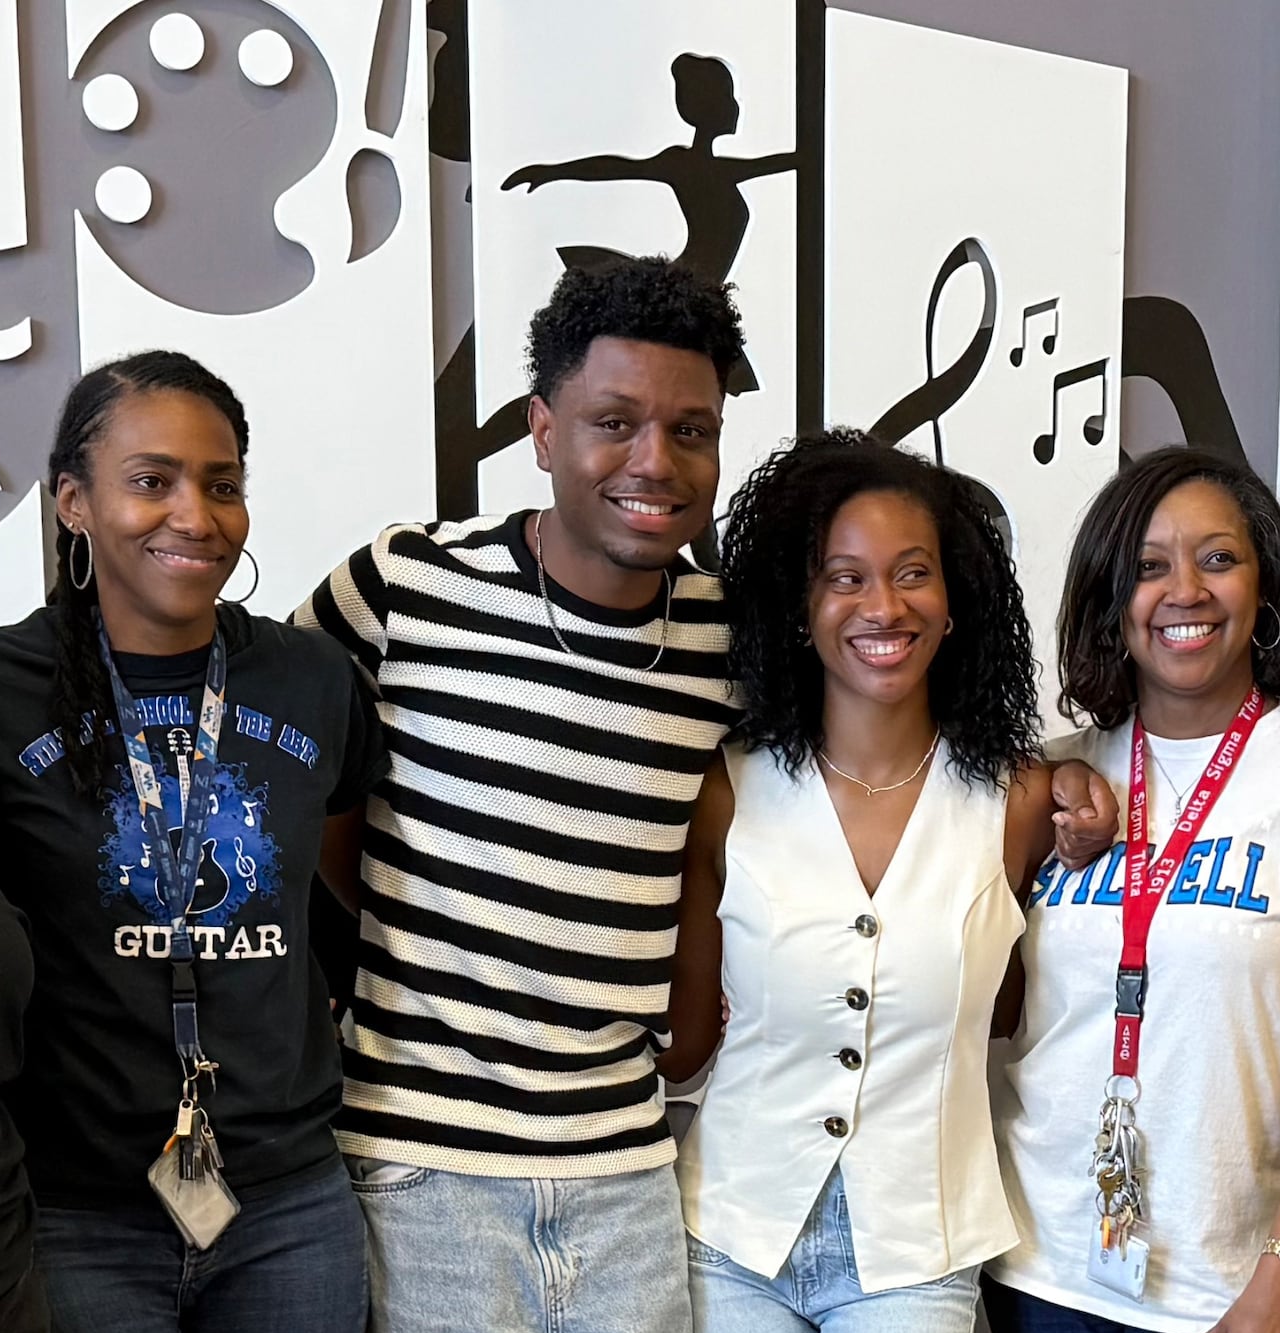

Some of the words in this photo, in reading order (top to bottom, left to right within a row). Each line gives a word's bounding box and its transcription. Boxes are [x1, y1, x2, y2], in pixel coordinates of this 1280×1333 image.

[1134, 738, 1144, 785] Delta
[1131, 791, 1145, 842] Sigma
[1147, 857, 1175, 895] 1913
[1178, 789, 1211, 833] Delta
[1206, 730, 1242, 781] Sigma
[1130, 850, 1146, 897] Theta
[114, 924, 287, 960] GUTAR
